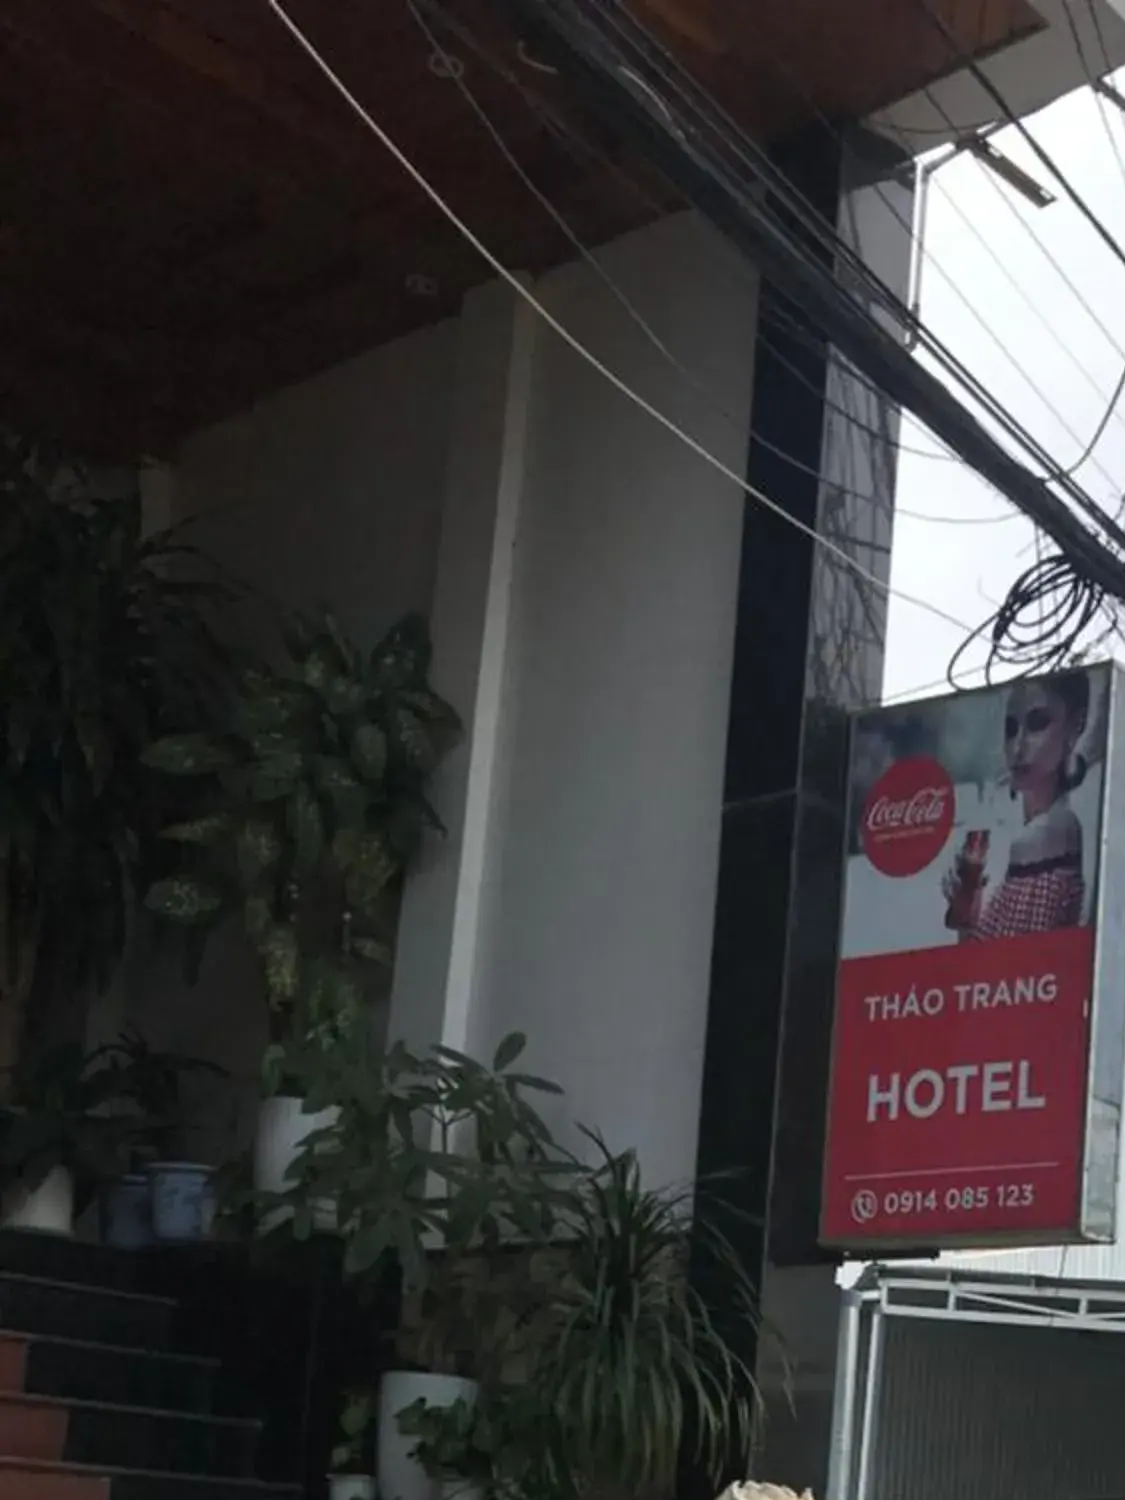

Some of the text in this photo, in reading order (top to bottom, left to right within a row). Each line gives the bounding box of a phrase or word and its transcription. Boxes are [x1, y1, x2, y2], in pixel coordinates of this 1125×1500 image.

[953, 973, 1057, 1012] TRANG
[866, 1059, 1046, 1122] HOTEL
[884, 1184, 1034, 1215] 0914 085 123
